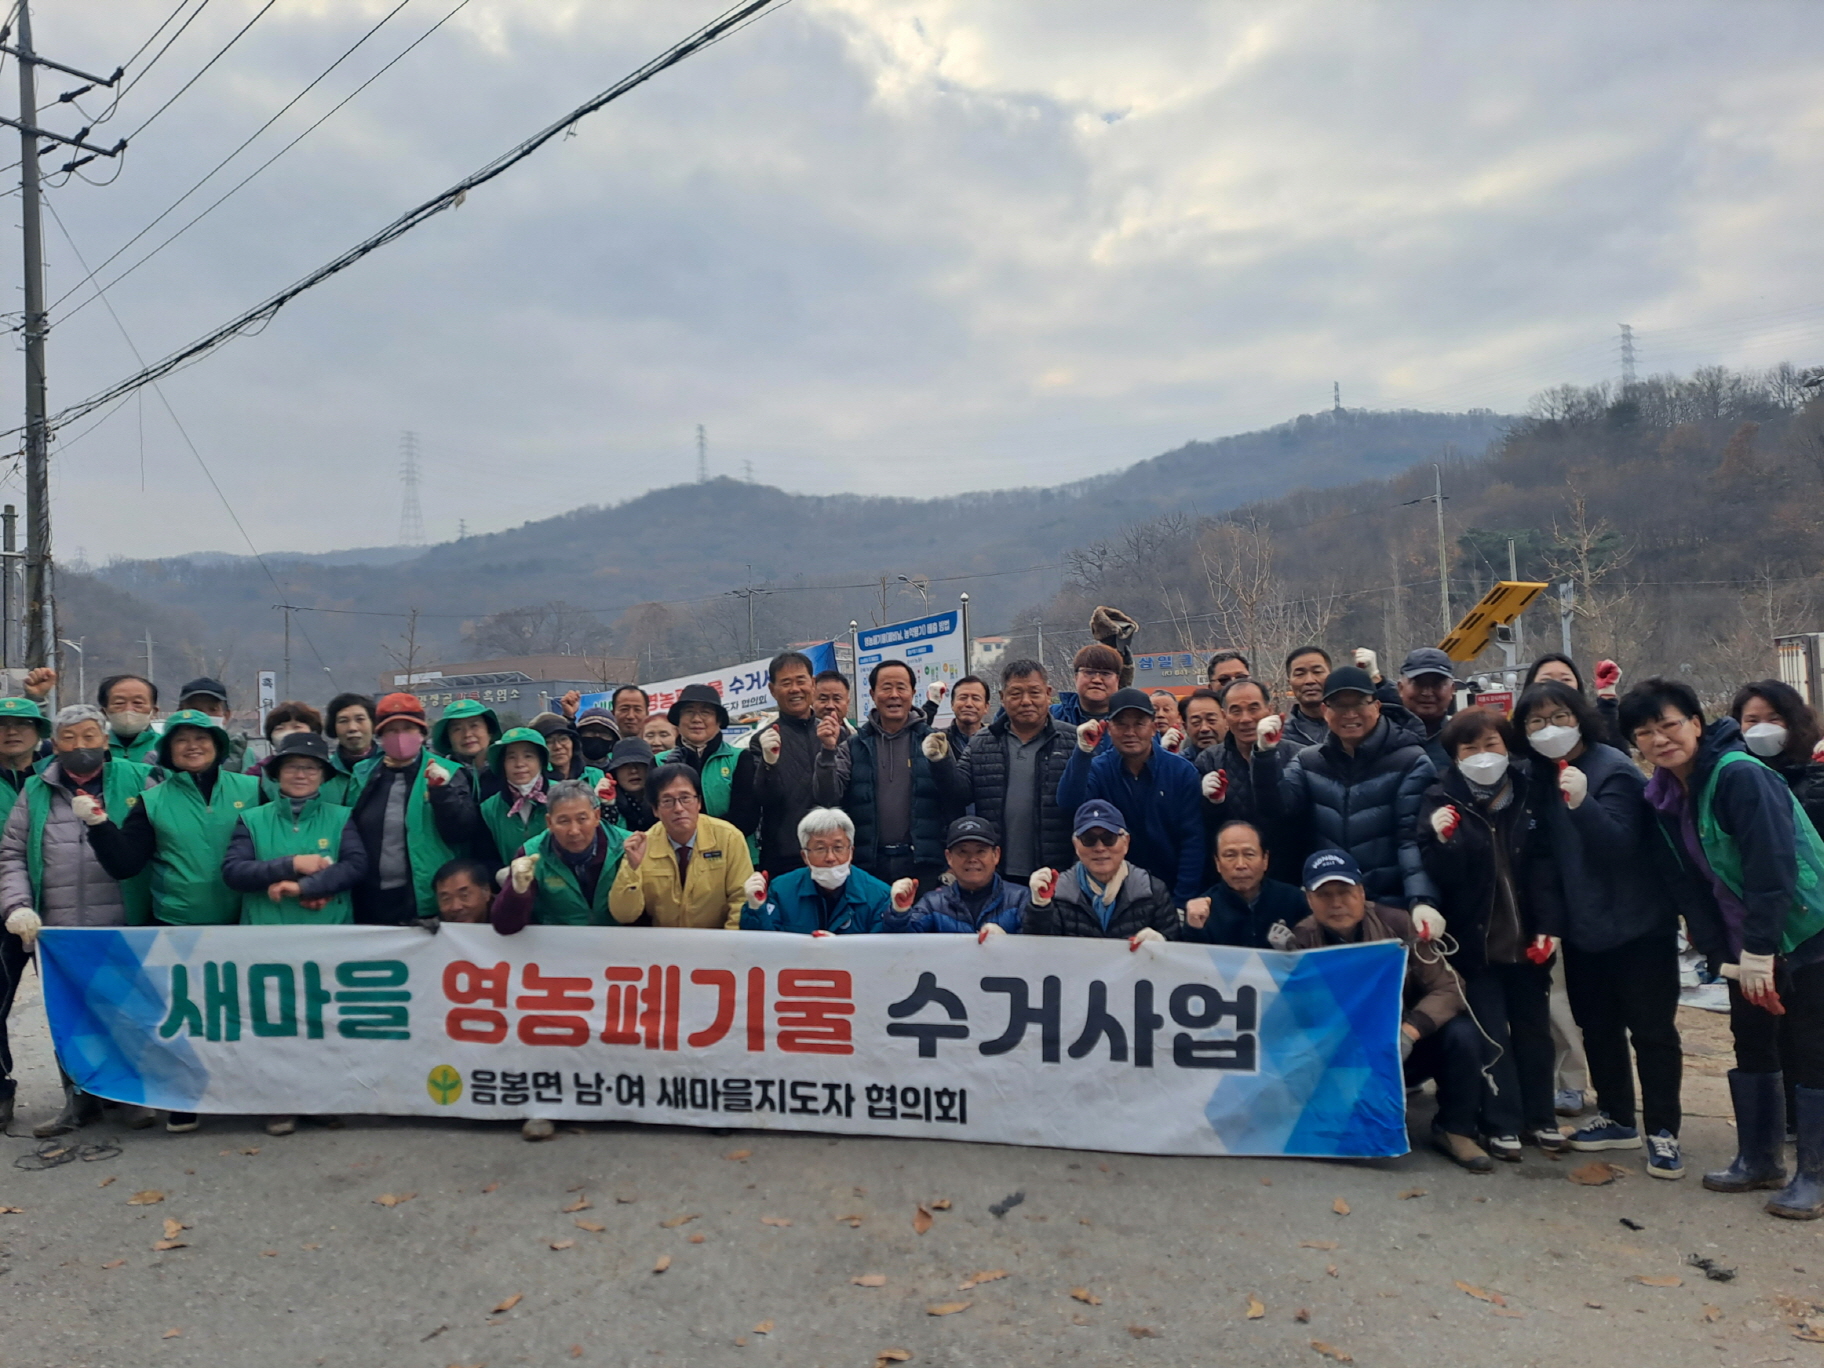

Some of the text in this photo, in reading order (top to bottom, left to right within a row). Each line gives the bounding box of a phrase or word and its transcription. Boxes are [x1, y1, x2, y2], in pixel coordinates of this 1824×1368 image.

[483, 688, 520, 702] 흑염소
[158, 959, 1257, 1071] 새마을 영농폐기물 수거사업
[470, 1069, 563, 1106] 음봉면
[657, 1076, 855, 1119] 새마을지도자
[865, 1083, 967, 1124] 협의회
